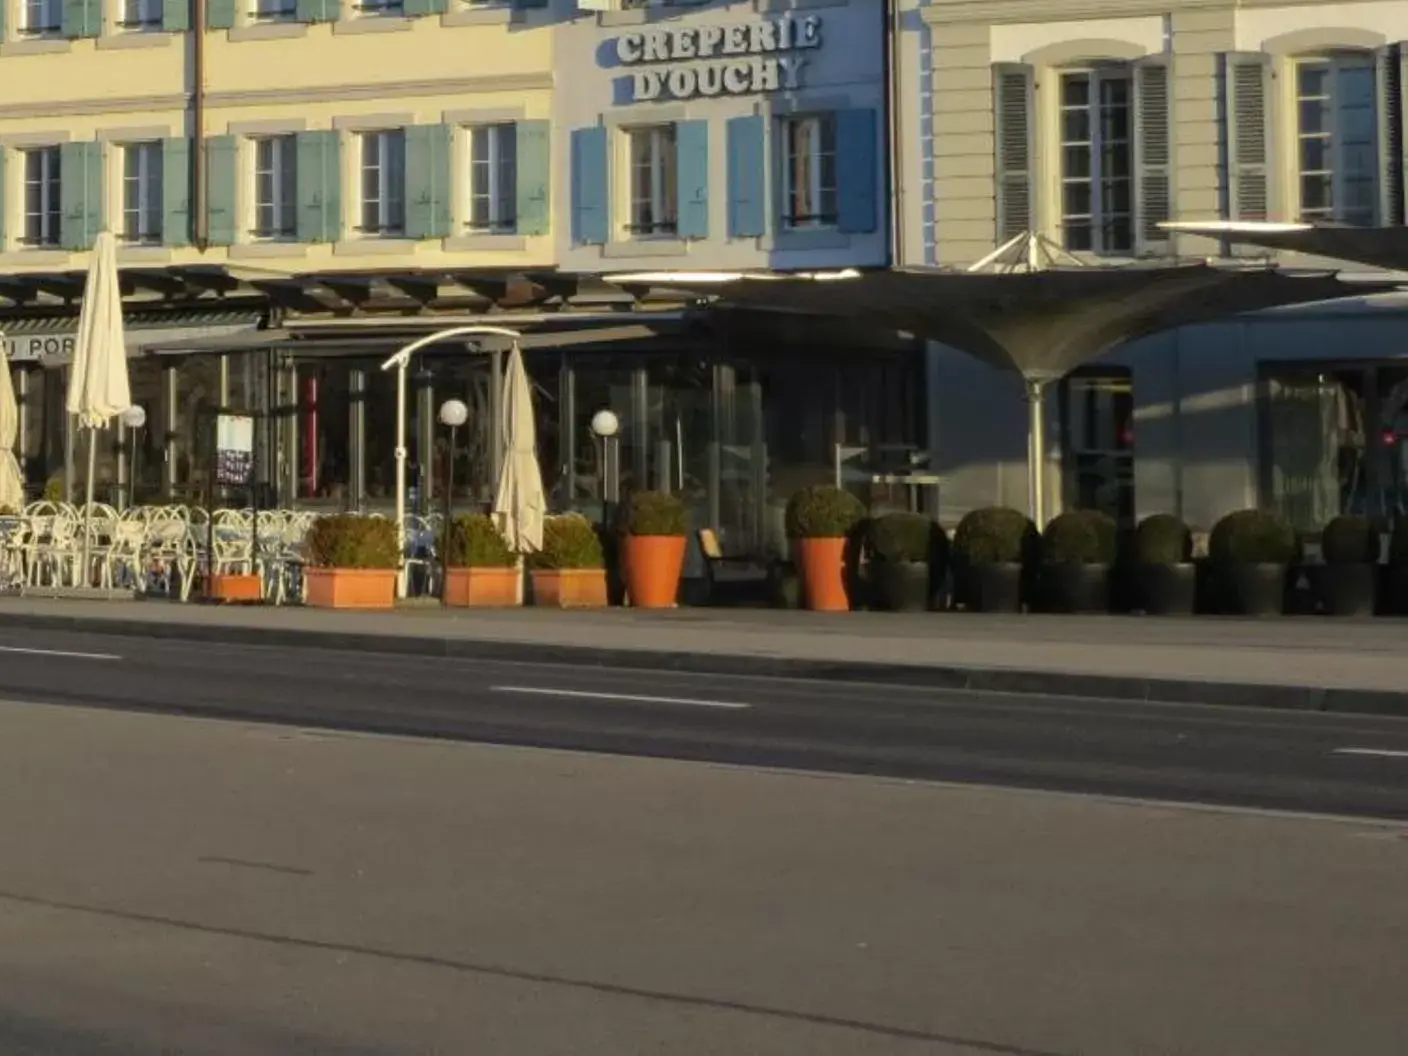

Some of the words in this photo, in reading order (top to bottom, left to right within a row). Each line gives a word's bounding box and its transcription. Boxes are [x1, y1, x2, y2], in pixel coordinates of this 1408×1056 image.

[617, 13, 821, 62] CREPERIE
[634, 54, 805, 100] D'OUCHY
[29, 337, 76, 356] POR
